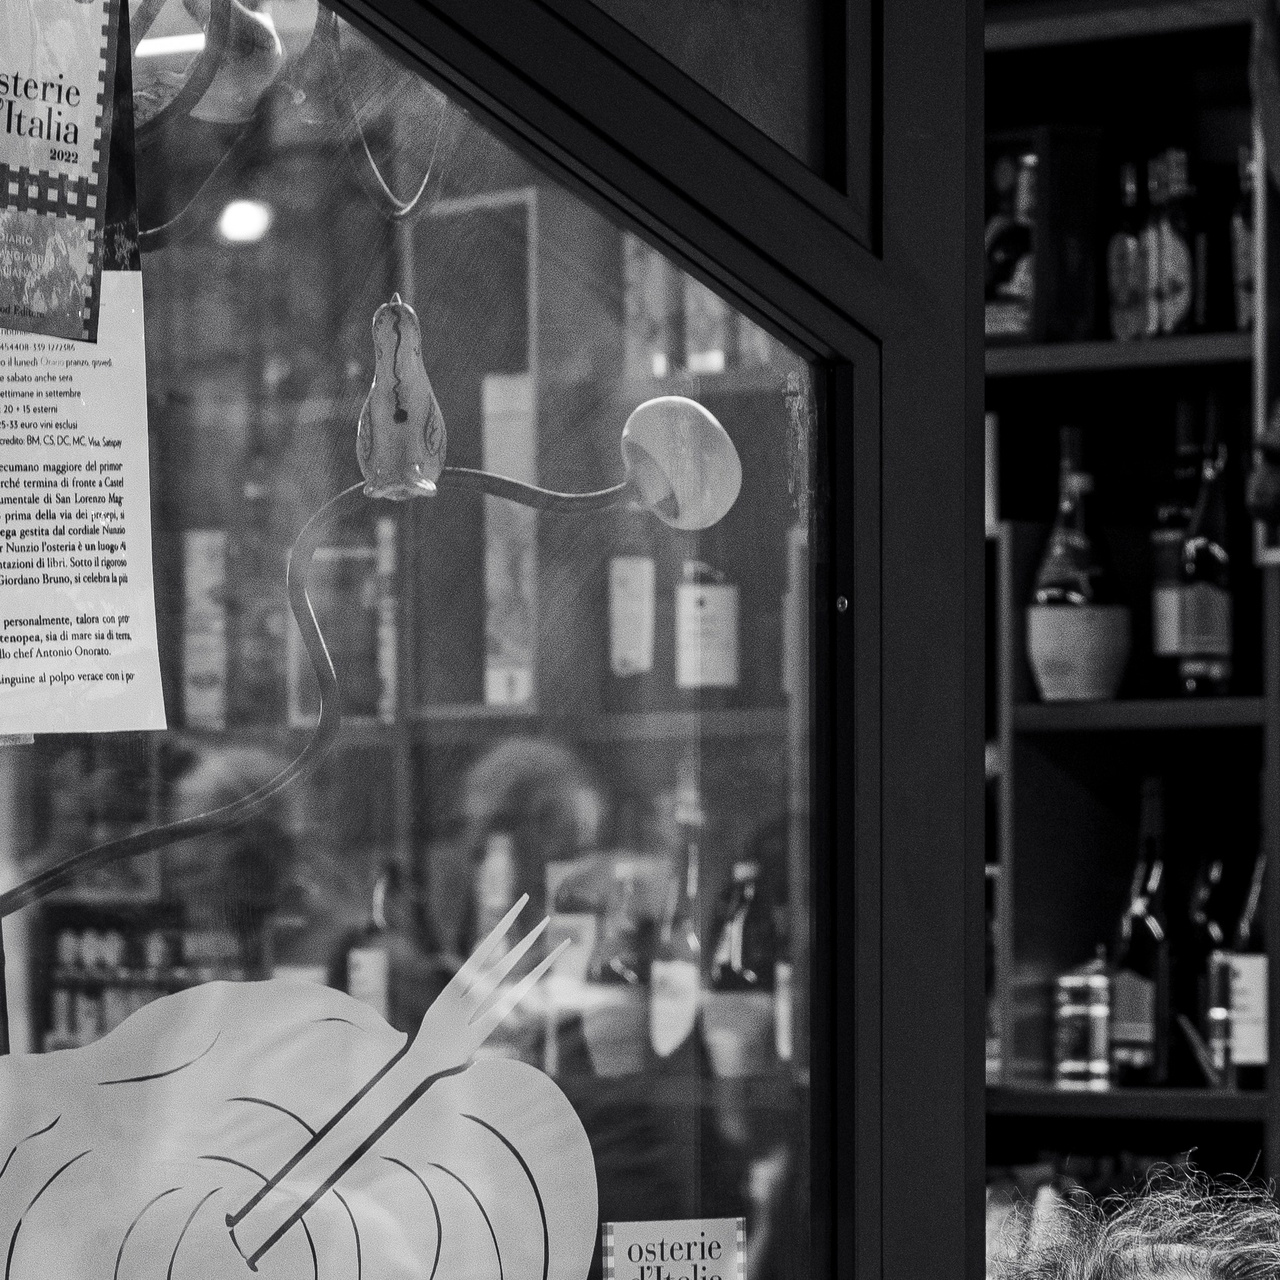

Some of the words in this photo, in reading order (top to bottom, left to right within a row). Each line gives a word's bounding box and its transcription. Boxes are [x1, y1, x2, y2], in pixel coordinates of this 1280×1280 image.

[0, 71, 80, 107] sterie
[50, 148, 78, 163] 2022
[7, 372, 32, 382] sabato
[34, 372, 57, 382] anche
[59, 374, 73, 382] sera
[36, 389, 43, 398] in
[45, 387, 81, 398] settembre
[4, 405, 13, 413] 20
[23, 405, 30, 413] 15
[33, 404, 58, 413] esterni
[40, 420, 53, 429] vini
[55, 419, 78, 429] esclusi
[43, 461, 82, 475] maggiore
[85, 460, 97, 472] del
[23, 477, 58, 488] termina
[60, 477, 69, 488] di
[72, 476, 96, 488] fronte
[43, 493, 52, 504] di
[56, 493, 71, 504] San
[74, 493, 106, 504] Lorenzo
[5, 509, 32, 524] prima
[35, 508, 57, 520] della
[60, 509, 72, 520] via
[75, 508, 88, 520] dei
[19, 526, 50, 539] gestita
[52, 525, 66, 536] dal
[68, 524, 100, 535] cordiale
[102, 524, 126, 535] Nunzio
[6, 542, 40, 553] Nunzio
[42, 541, 76, 552] l'osteria
[85, 543, 96, 551] un
[98, 540, 119, 554] luogo
[36, 557, 45, 568] di
[47, 557, 68, 568] libri.
[70, 556, 93, 567] Sotto
[95, 556, 100, 567] il
[0, 574, 40, 586] Giordano
[42, 573, 73, 585] Bruno,
[75, 573, 81, 584] si
[83, 572, 110, 583] celebra
[112, 572, 118, 583] la
[4, 614, 73, 630] personalmente,
[76, 613, 99, 625] talora
[103, 615, 116, 624] con
[46, 631, 58, 641] sia
[60, 630, 69, 641] di
[72, 632, 92, 641] mare
[95, 629, 105, 641] sia
[107, 629, 114, 640] di
[14, 647, 34, 659] chef
[36, 646, 73, 658] Antonio
[75, 645, 112, 657] Onorato.
[39, 672, 46, 682] al
[49, 671, 75, 685] polpo
[78, 673, 104, 682] verace
[106, 672, 119, 681] con
[628, 1232, 722, 1262] osterie
